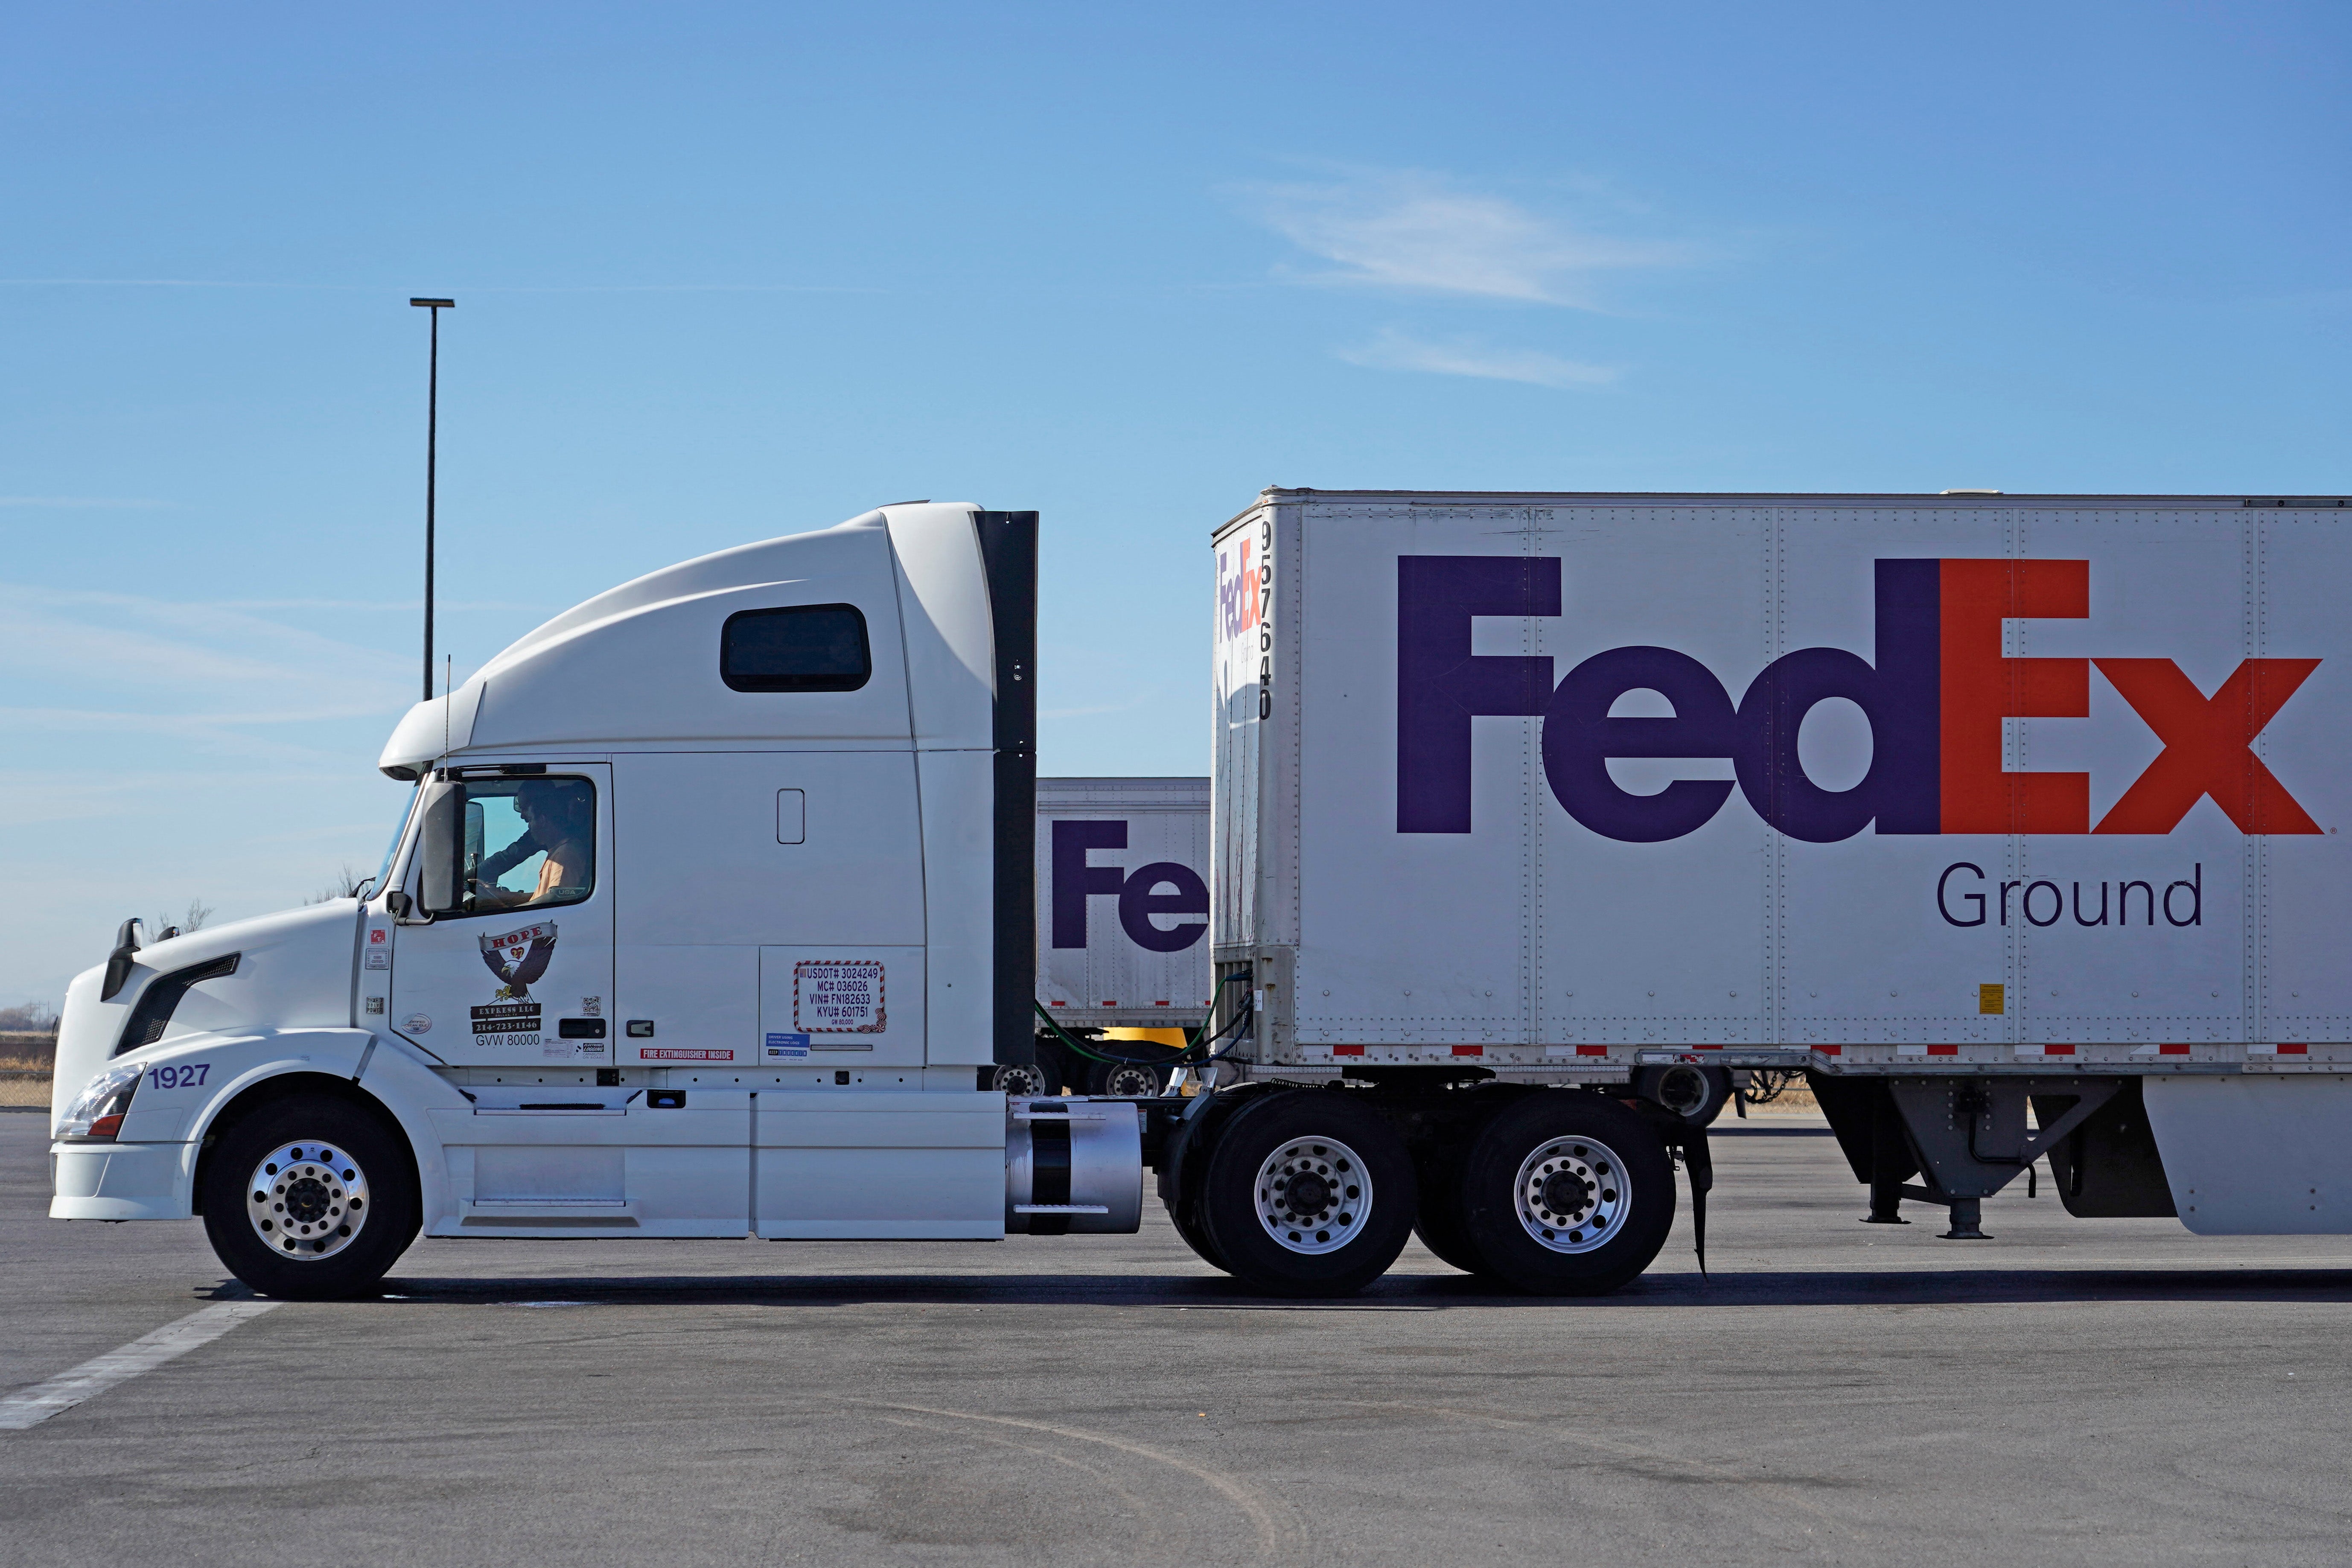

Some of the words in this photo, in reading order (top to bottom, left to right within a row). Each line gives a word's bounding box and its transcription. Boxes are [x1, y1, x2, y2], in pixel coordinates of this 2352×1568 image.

[1220, 537, 1262, 643] FedEx
[1259, 521, 1271, 720] 957640
[1396, 555, 2326, 843] FedEx
[1052, 820, 1209, 952] Fe
[1937, 862, 2202, 927] Ground
[491, 927, 542, 948] HOPE
[511, 948, 524, 958] 27
[807, 968, 839, 979] USDOT#
[842, 968, 878, 979] 3024249
[817, 981, 834, 991] MC#
[837, 981, 868, 991] 036026
[810, 994, 829, 1004] VIN#
[831, 994, 870, 1004] FN182633
[479, 1006, 516, 1015] EXPRESS
[817, 1006, 839, 1017] KYU#
[842, 1006, 868, 1017] 601751
[476, 1021, 537, 1032] 214-723-1146
[476, 1035, 504, 1046] GVW
[507, 1034, 539, 1046] 80000
[643, 1049, 658, 1058] FIRE
[659, 1050, 707, 1059] EXTINGUISHER
[708, 1050, 731, 1059] INSIDE
[148, 1064, 210, 1090] 1927
